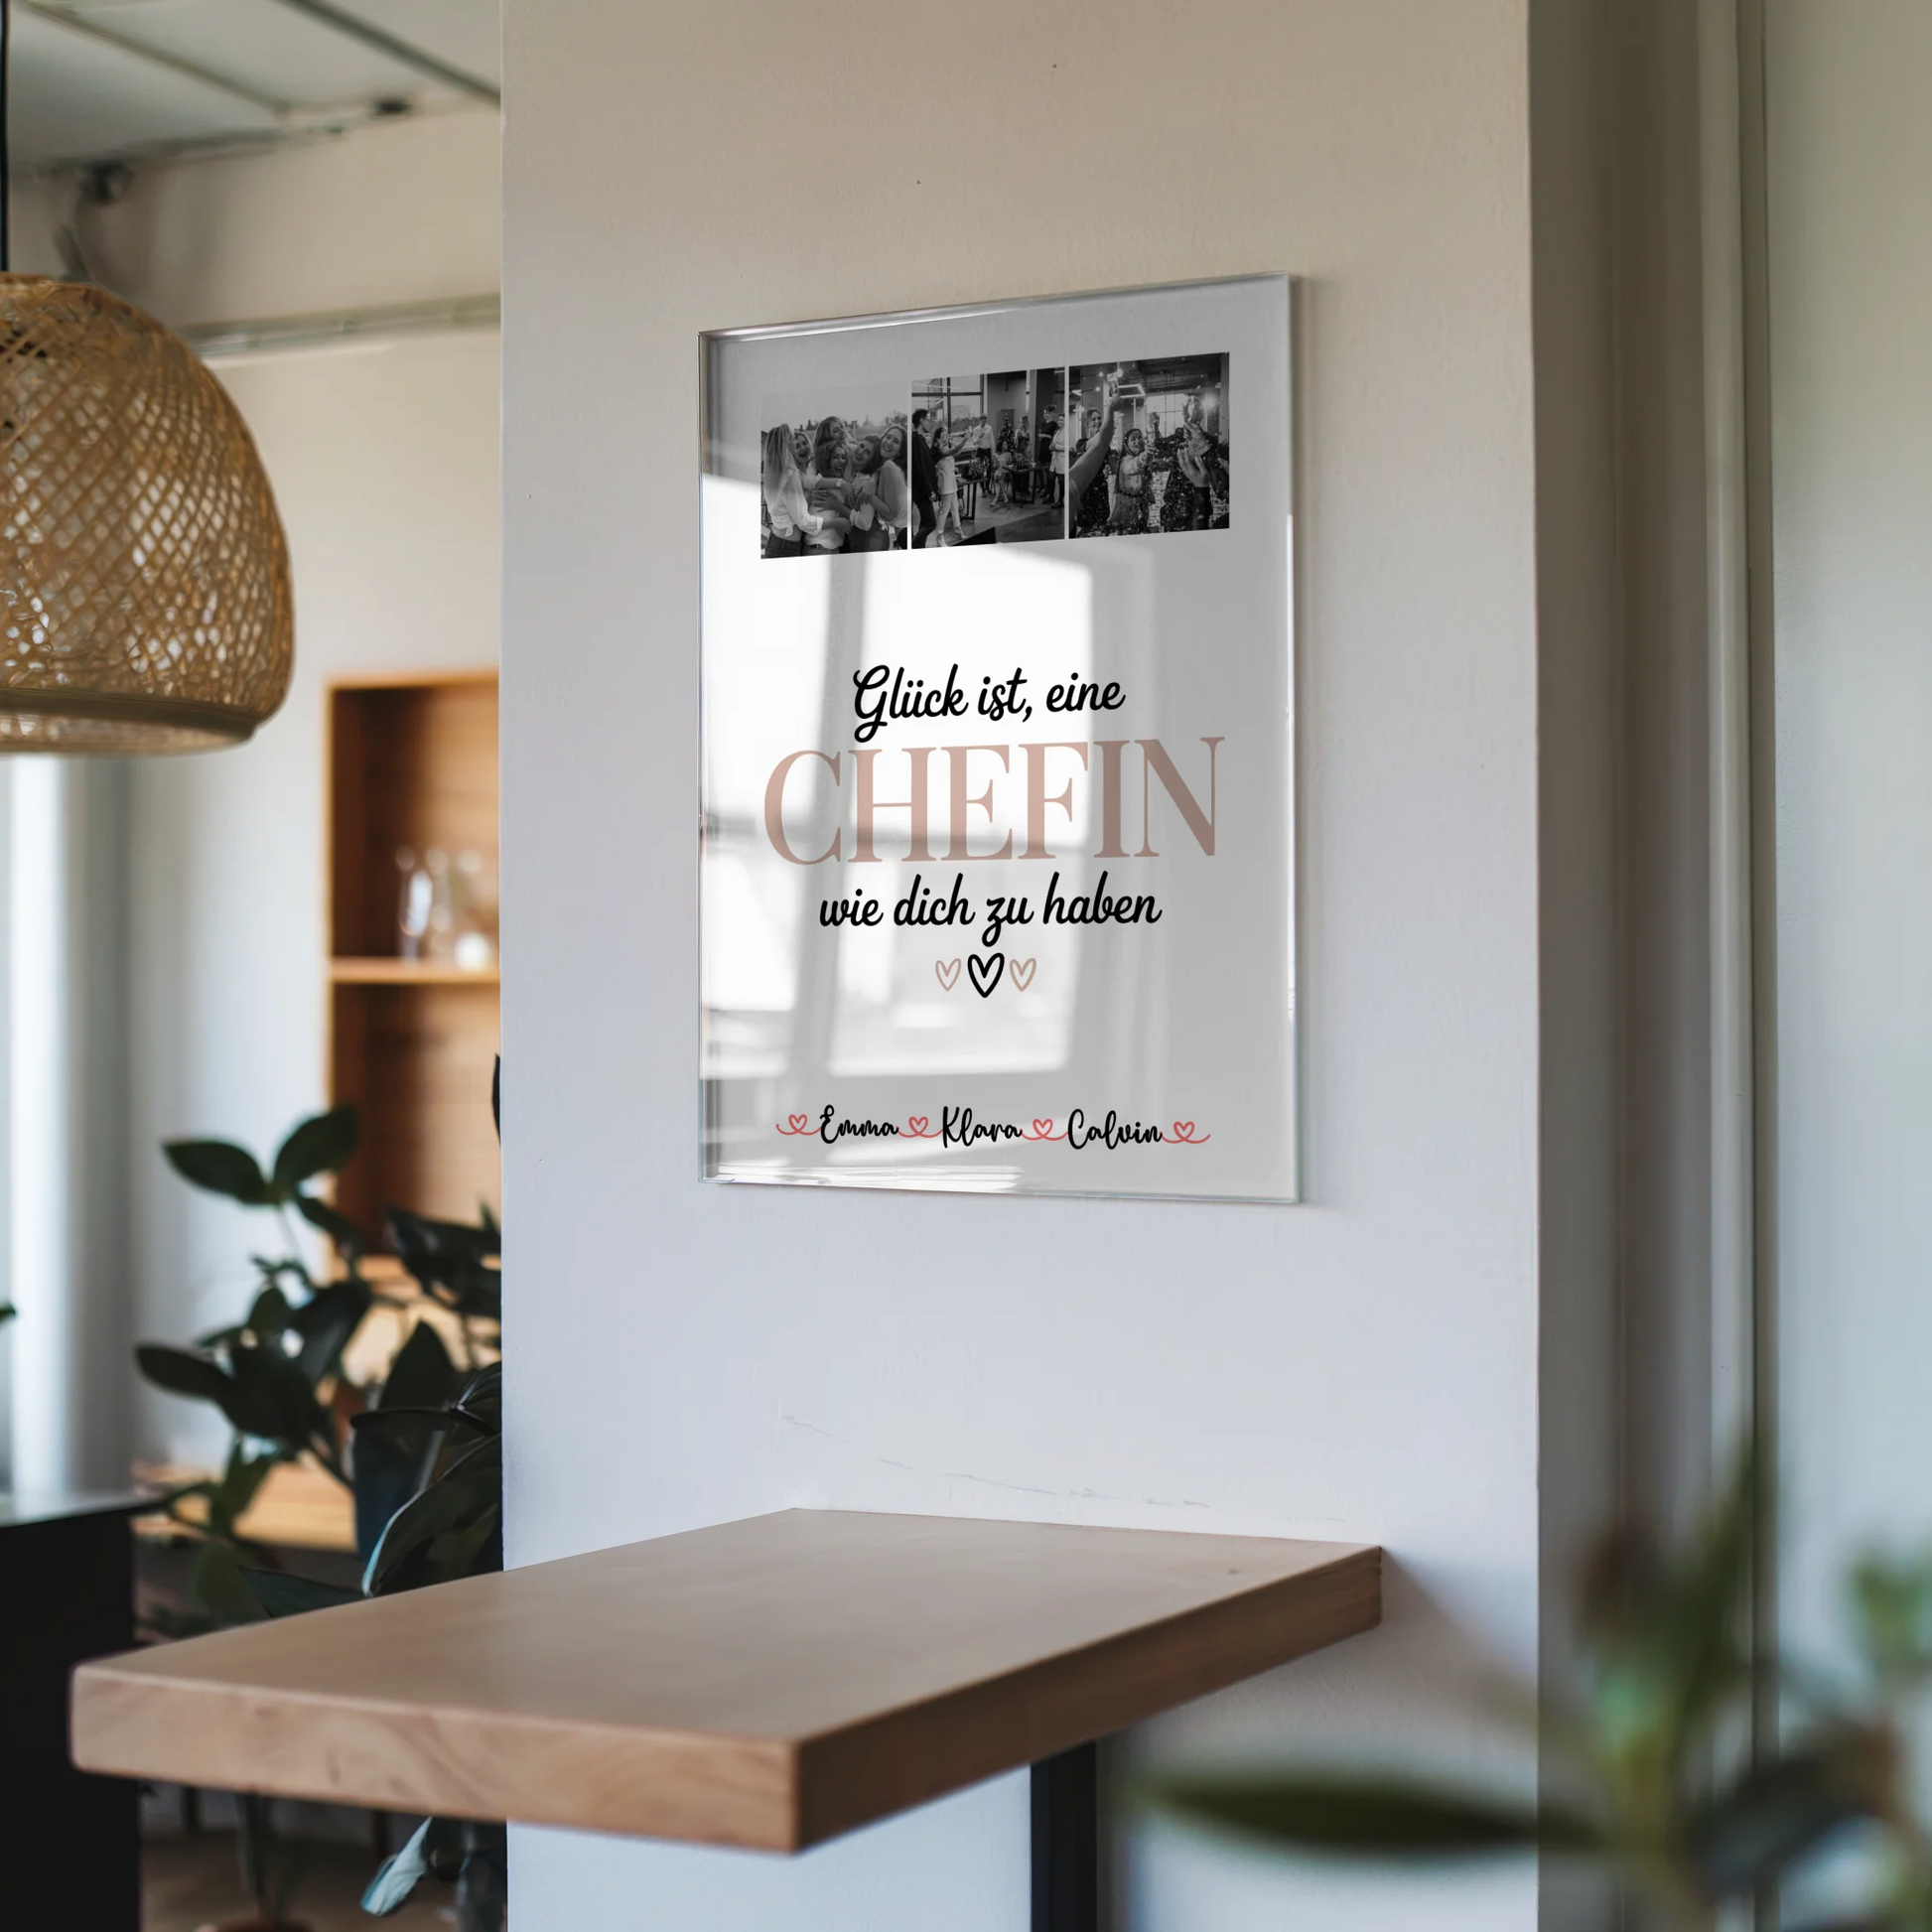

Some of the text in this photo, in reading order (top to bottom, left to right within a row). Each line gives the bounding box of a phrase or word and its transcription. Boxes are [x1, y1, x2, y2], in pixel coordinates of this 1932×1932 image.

[853, 663, 1127, 744] Glück ist, eine
[763, 736, 1226, 867] CHEFIN
[819, 870, 1164, 948] wie dich zu haben
[819, 1104, 1164, 1151] Emma Klara Calvin
